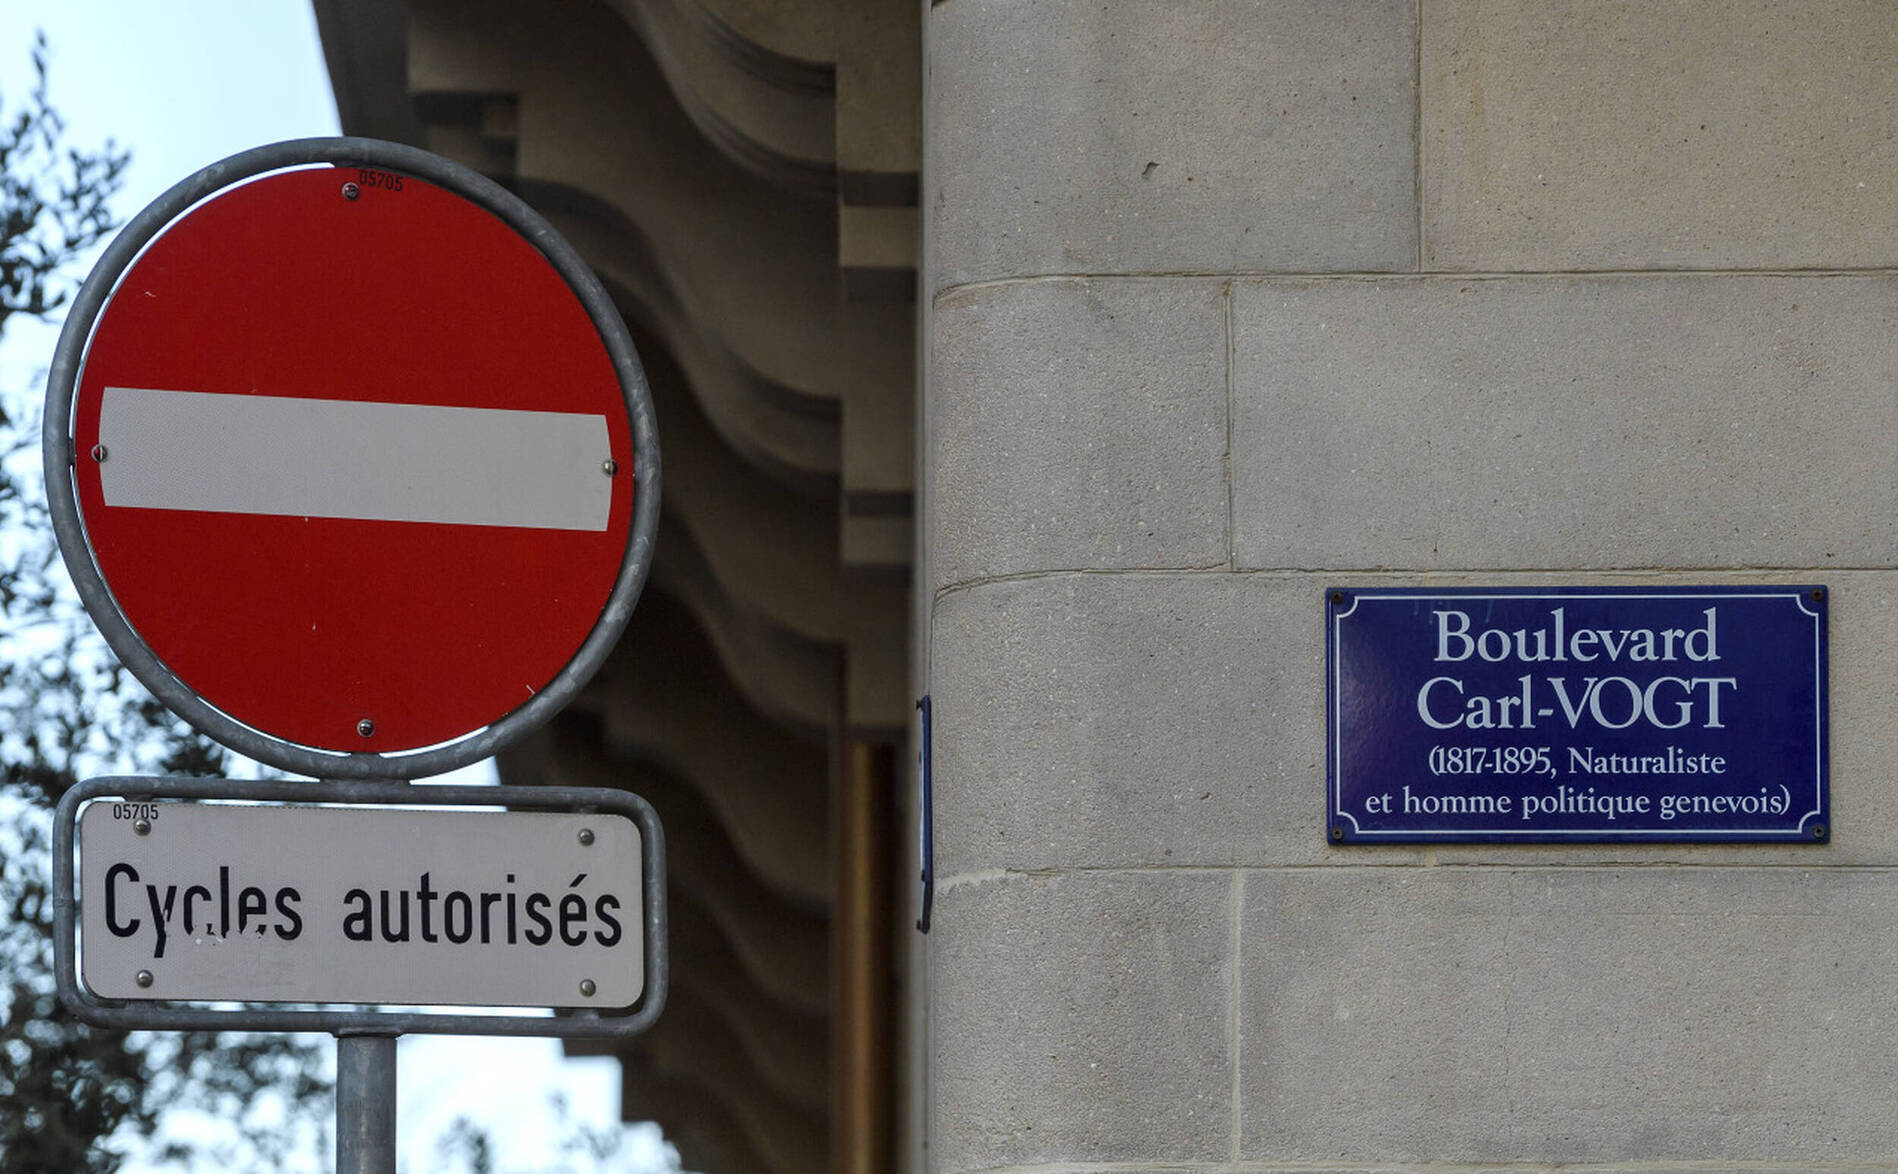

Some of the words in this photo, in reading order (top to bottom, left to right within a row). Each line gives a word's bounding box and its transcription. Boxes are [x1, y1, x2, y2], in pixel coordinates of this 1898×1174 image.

[359, 169, 403, 191] 05705
[1433, 607, 1720, 662] Boulevard
[1417, 674, 1737, 729] Carl-VOGT
[1429, 746, 1557, 778] (1817-1895,
[1568, 746, 1726, 775] Naturaliste
[113, 803, 159, 820] 05705
[1366, 792, 1392, 814] et
[1402, 786, 1512, 814] homme
[1522, 787, 1650, 819] politique
[1660, 784, 1791, 819] genevois)
[105, 862, 303, 958] Cycles
[343, 871, 622, 947] autorisés
